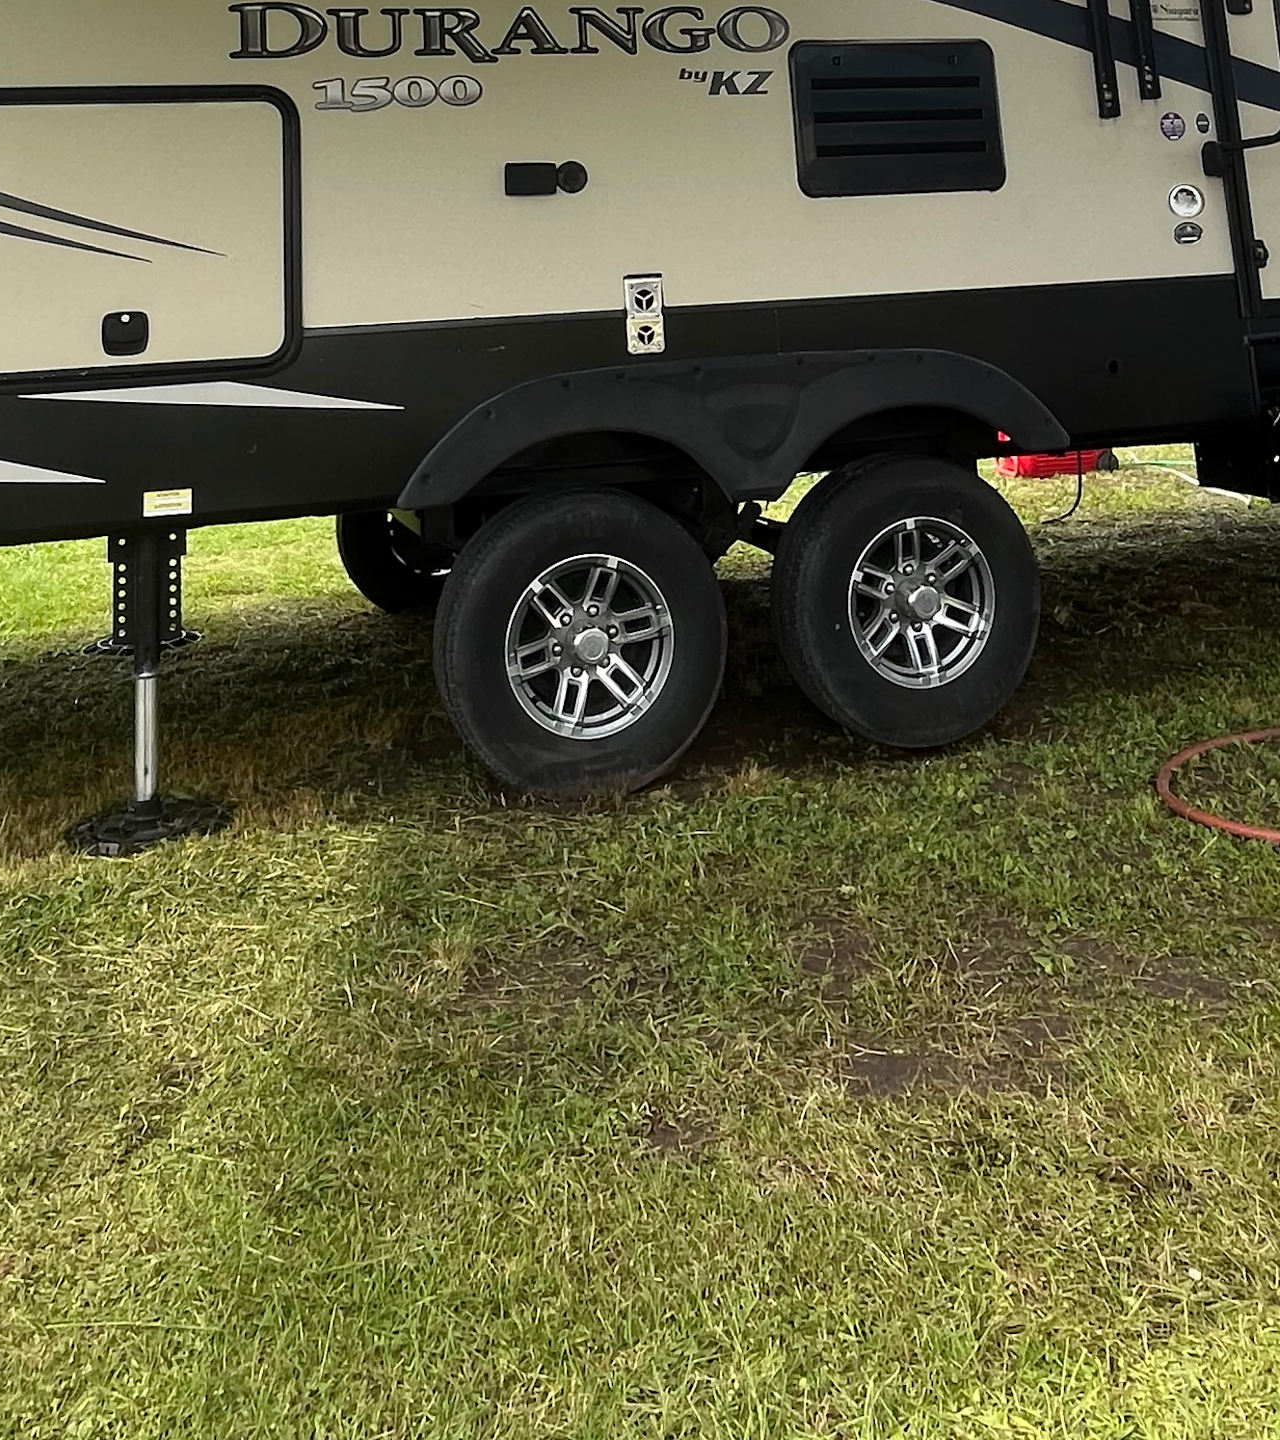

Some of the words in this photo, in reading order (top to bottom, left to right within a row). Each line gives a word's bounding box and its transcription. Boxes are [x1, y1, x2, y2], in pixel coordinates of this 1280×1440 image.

[228, 1, 791, 64] DURANGO
[312, 74, 483, 112] 1500
[678, 67, 708, 84] by
[707, 70, 776, 96] KZ
